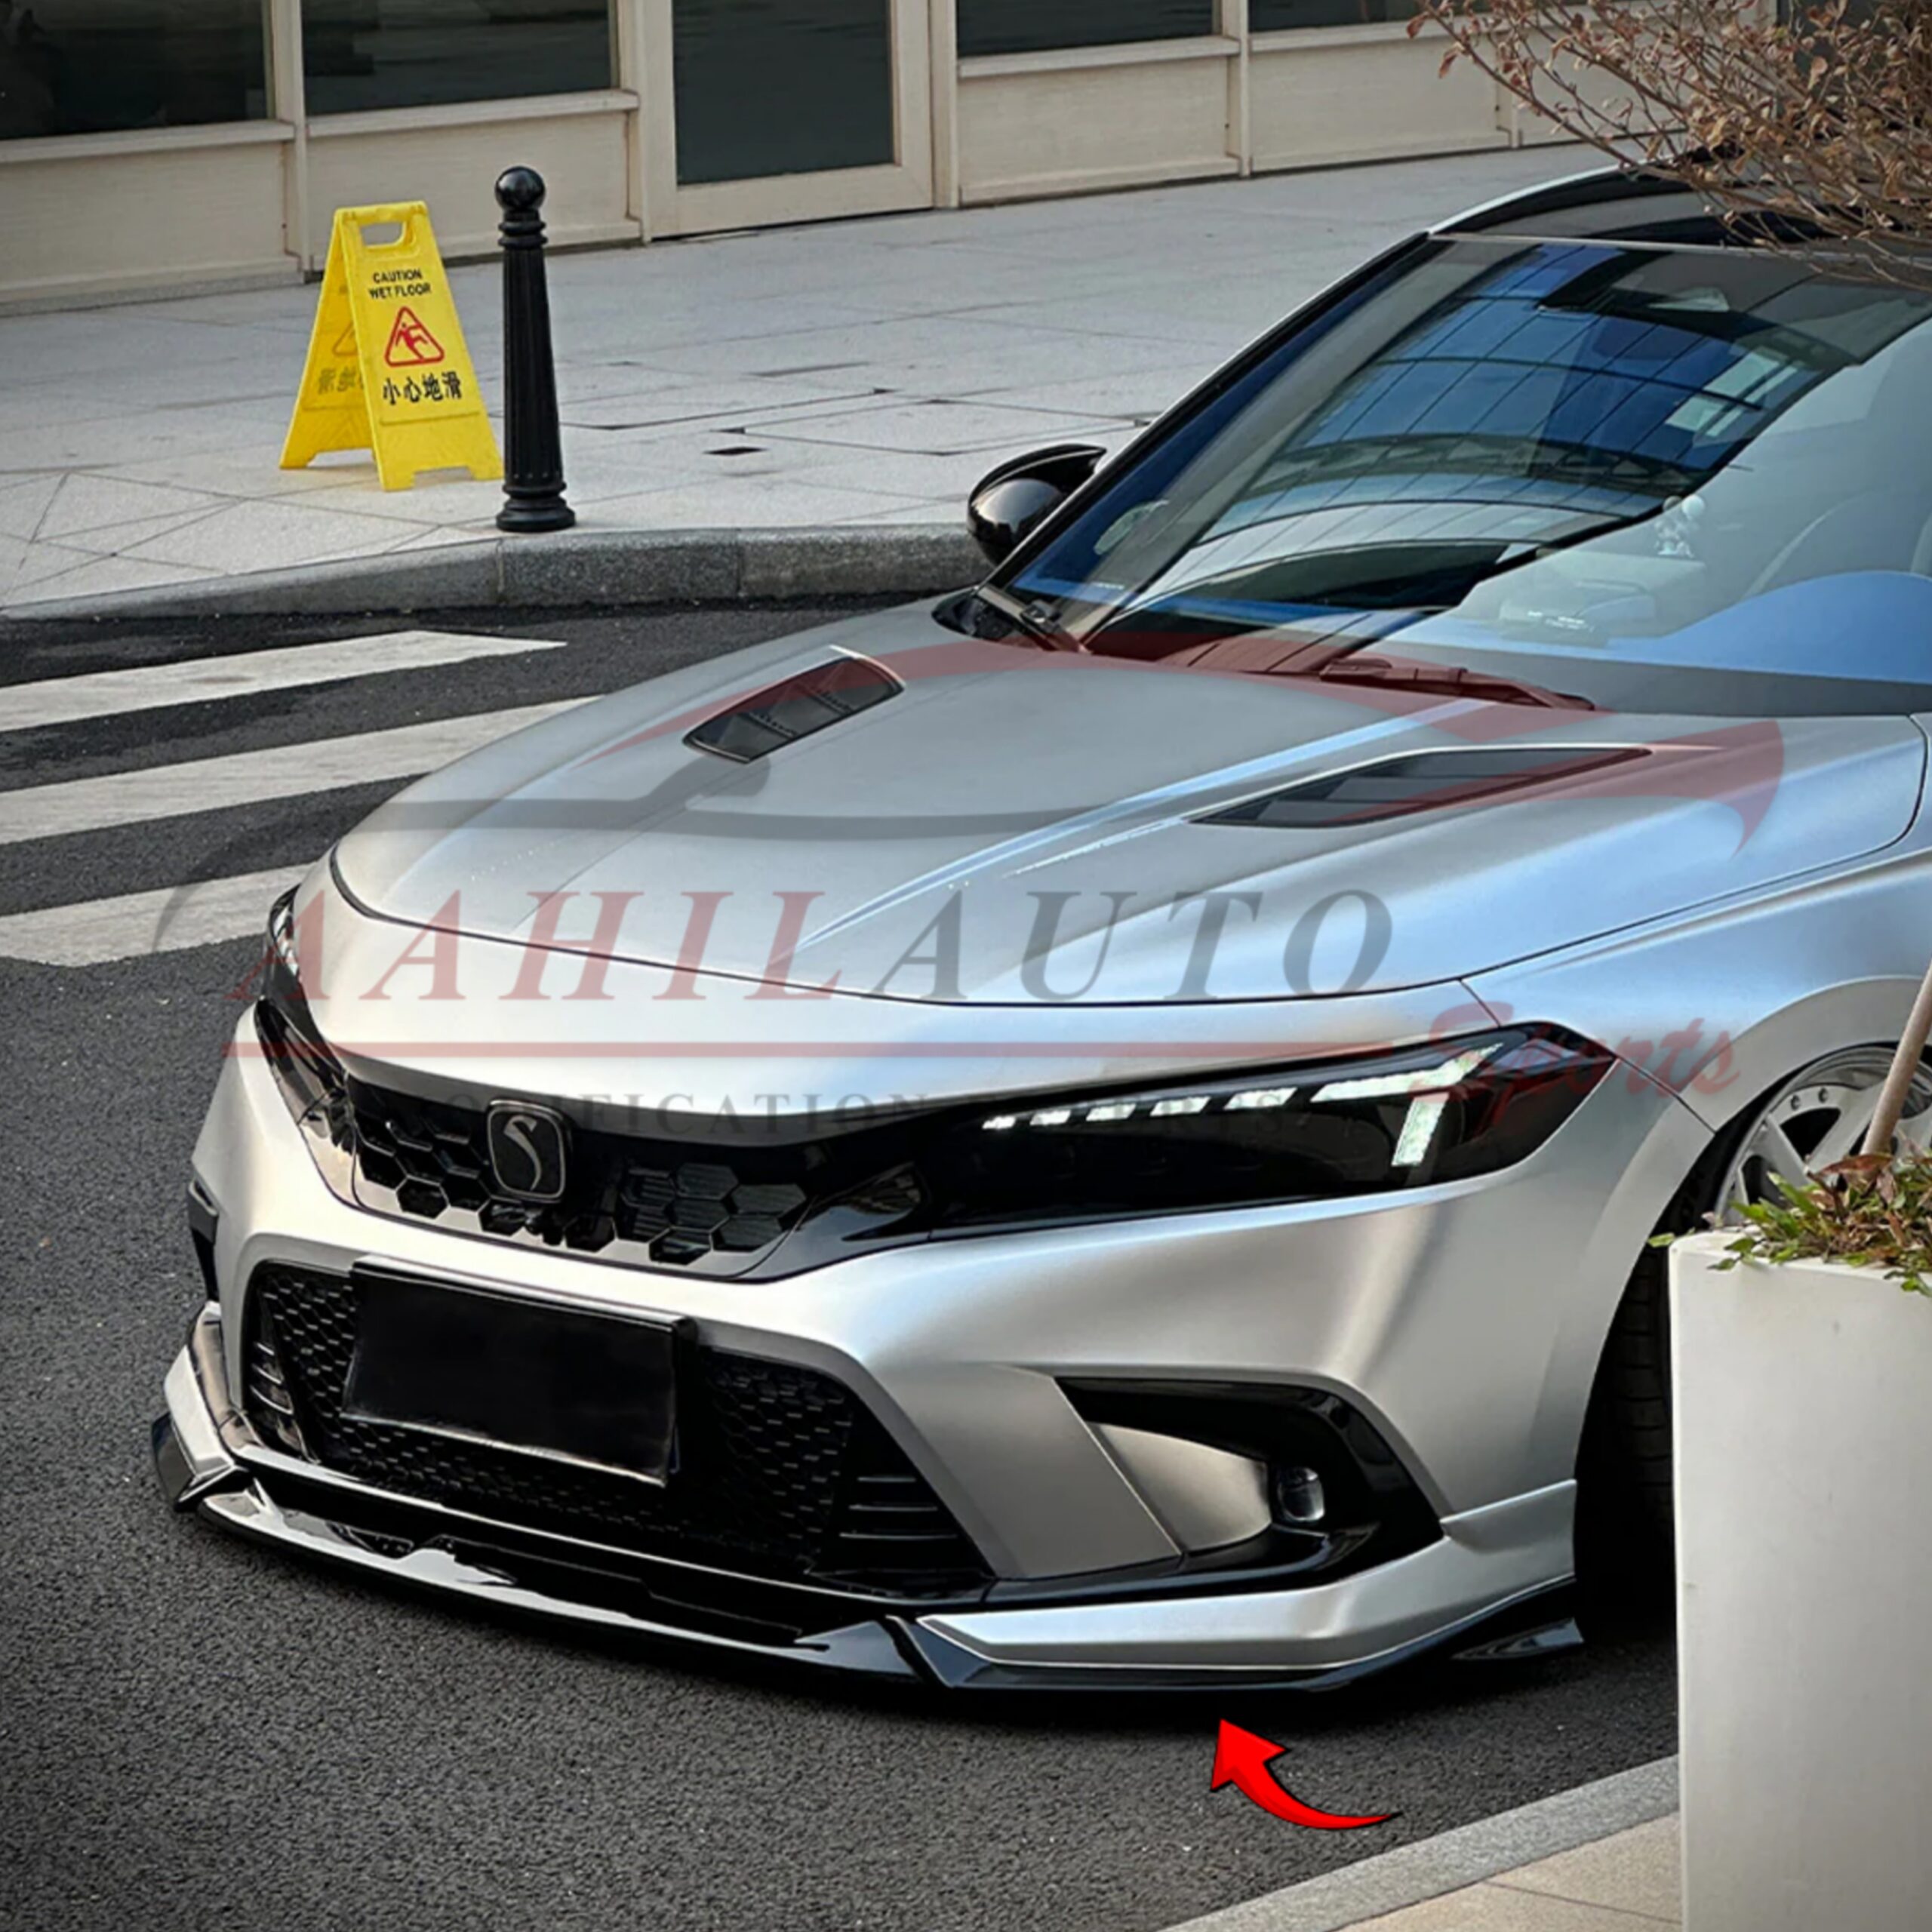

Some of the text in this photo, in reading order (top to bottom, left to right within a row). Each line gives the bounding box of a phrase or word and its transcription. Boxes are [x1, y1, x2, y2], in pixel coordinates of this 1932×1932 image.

[373, 269, 422, 284] CAUTION
[369, 282, 431, 299] WET FLOOR
[383, 371, 462, 405] 小心地滑
